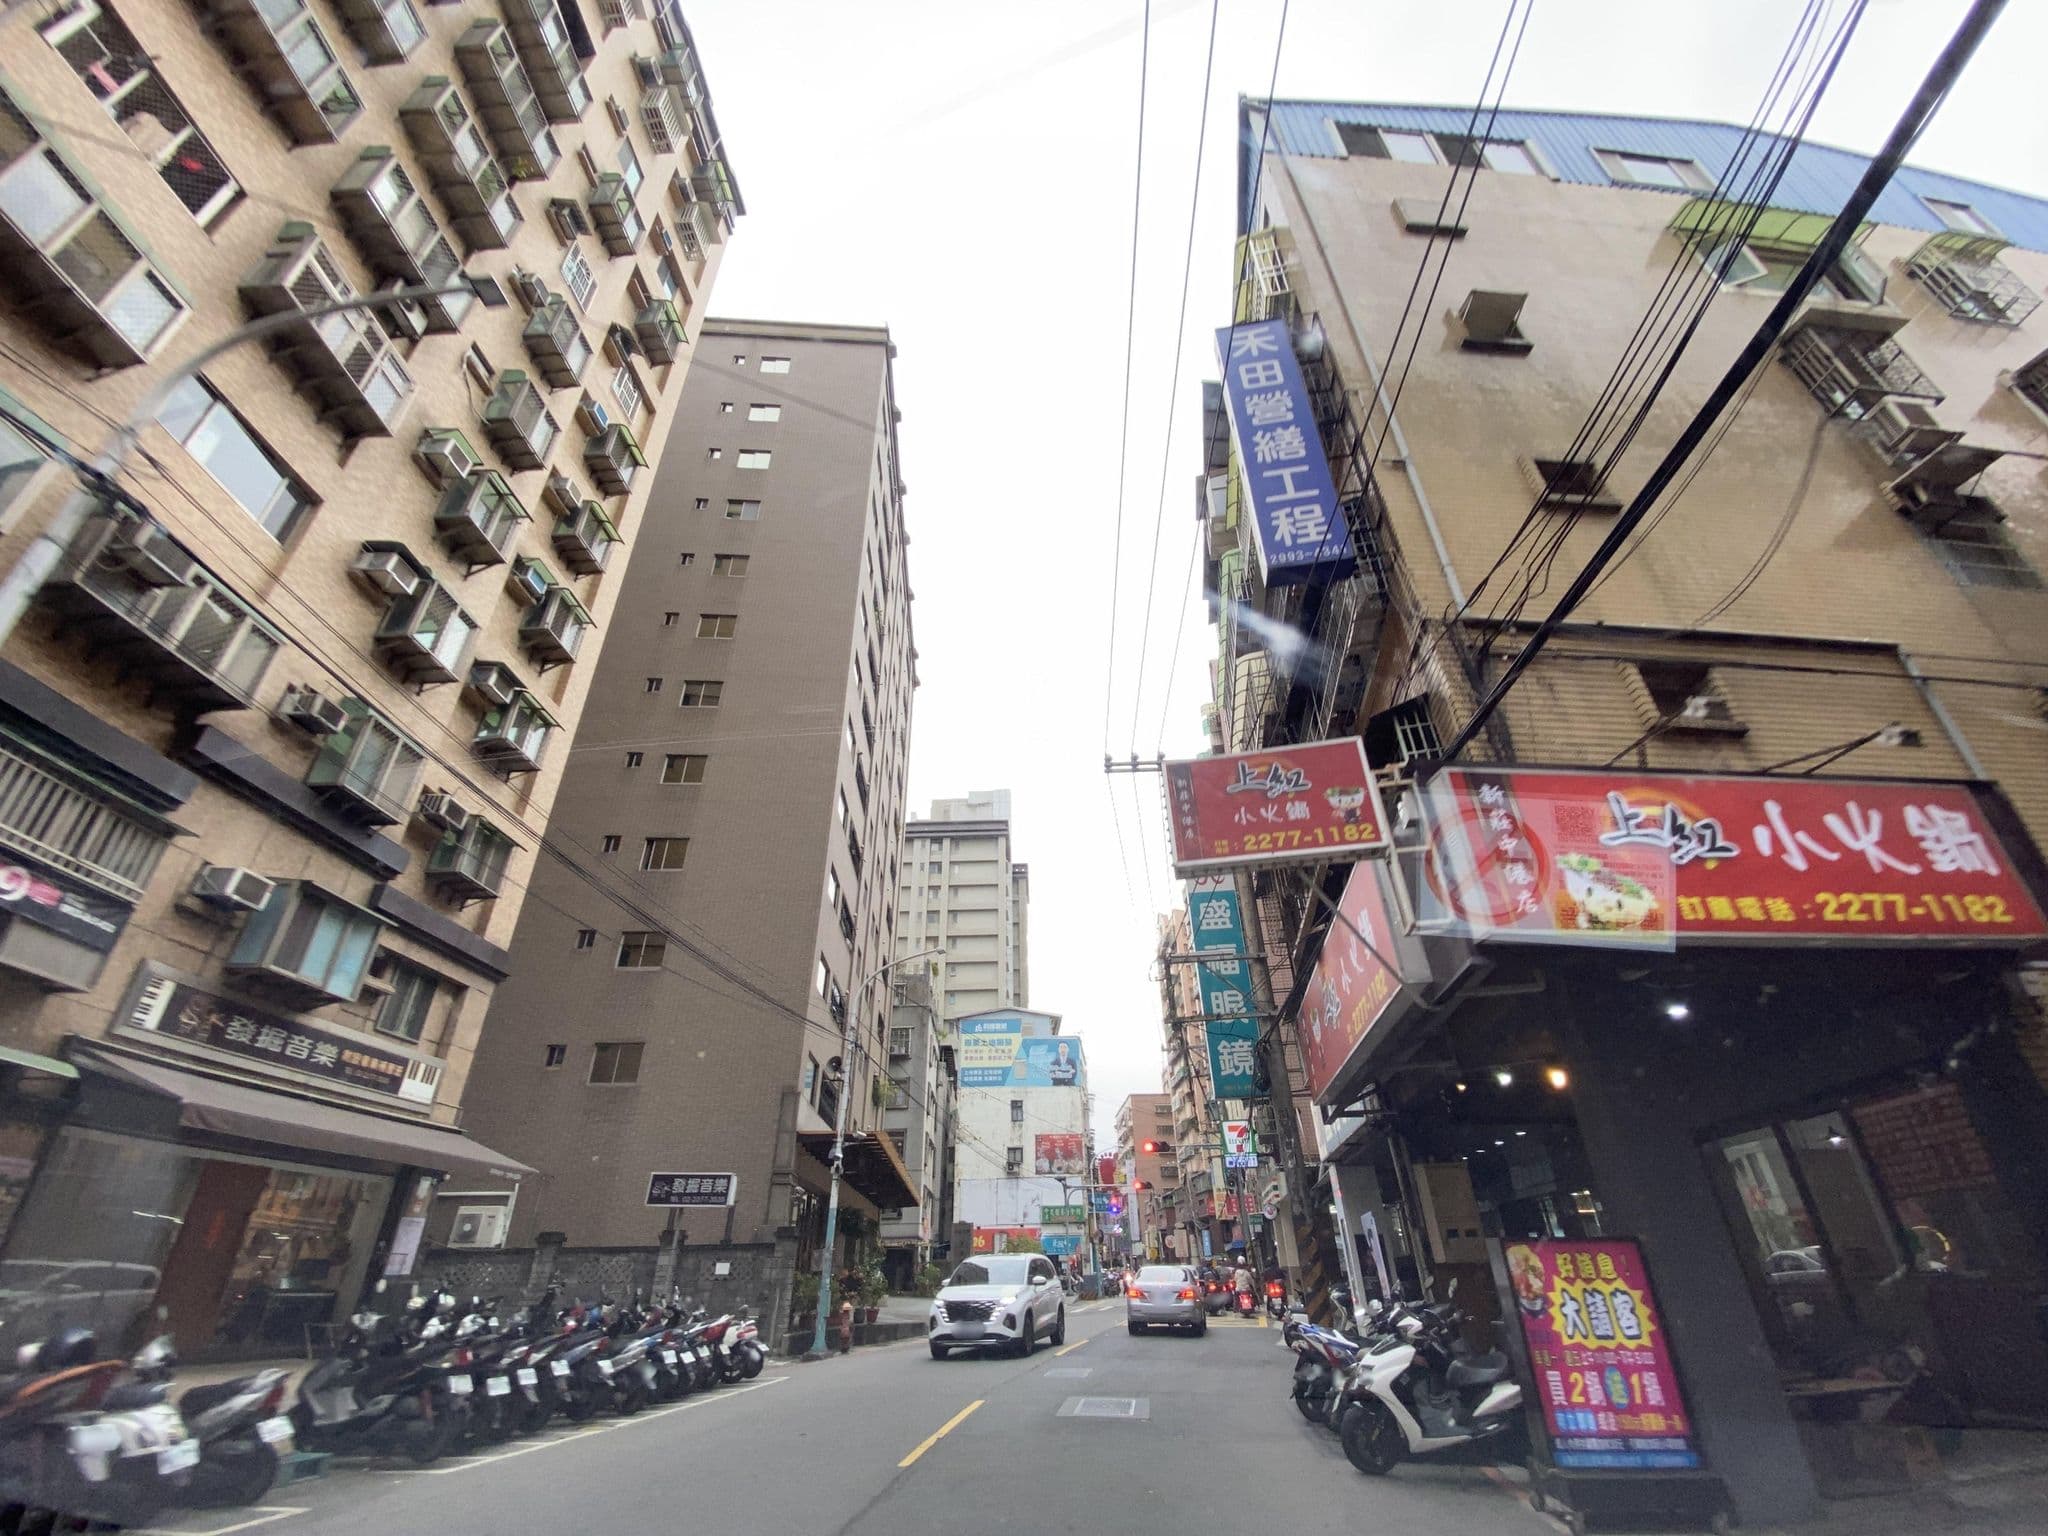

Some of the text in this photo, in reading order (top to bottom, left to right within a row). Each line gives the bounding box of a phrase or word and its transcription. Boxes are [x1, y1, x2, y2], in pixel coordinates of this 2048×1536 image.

[1231, 325, 1333, 548] 禾田營繕工程
[1226, 760, 1312, 798] 上紅
[1234, 801, 1311, 826] 小火鍋
[1243, 823, 1377, 851] 2277-1182
[1600, 790, 1740, 865] 上紅
[1752, 799, 2001, 877] 小火鍋
[1479, 783, 1538, 913] 新莊中港店
[1815, 892, 2016, 923] 2277-1182
[1199, 899, 1255, 1077] 盛福眼鏡
[225, 1014, 342, 1068] 發掘音樂
[672, 1178, 729, 1193] 發掘音樂
[1560, 1287, 1642, 1340] 大請客
